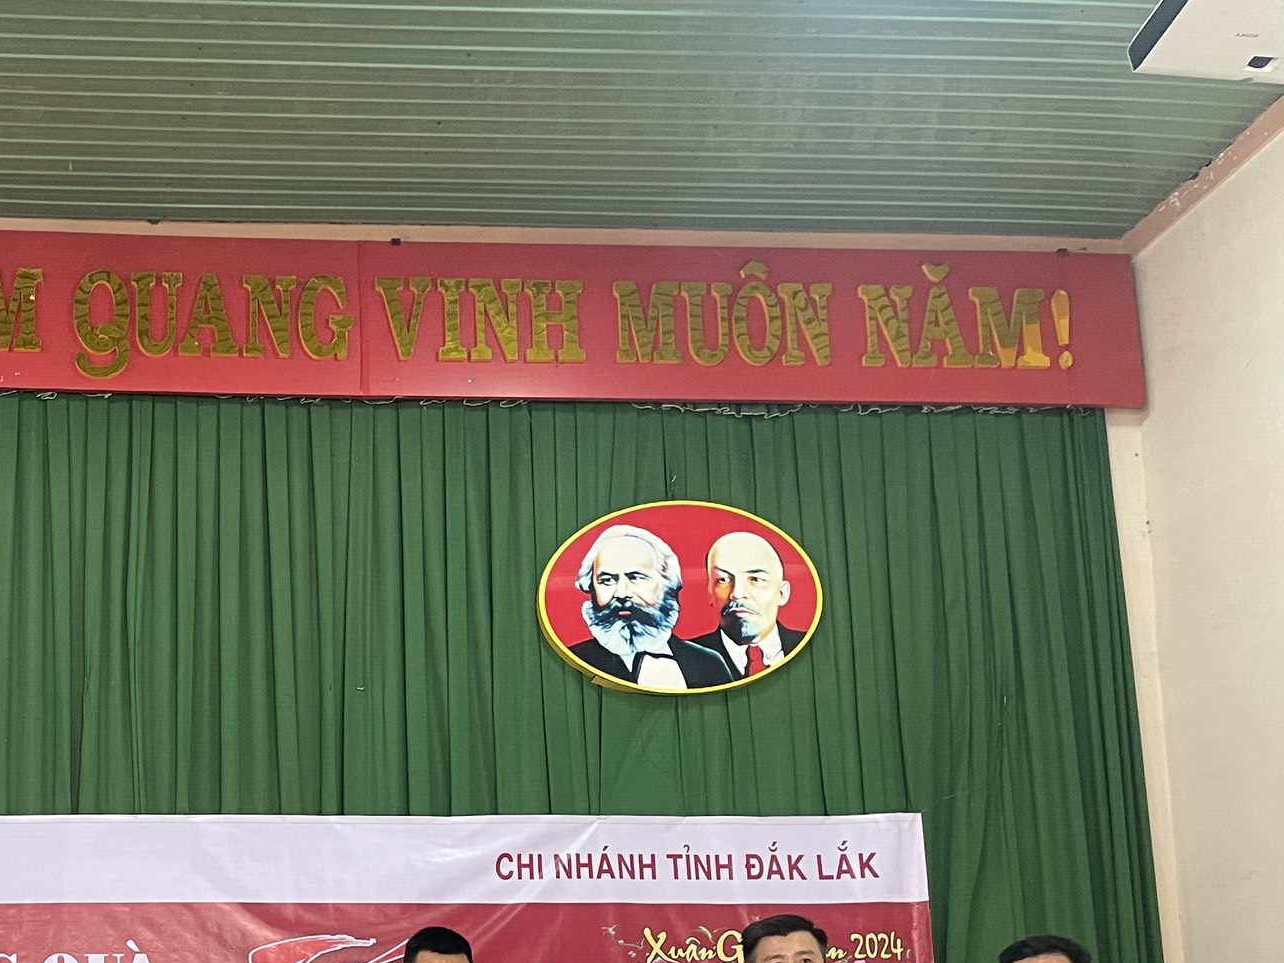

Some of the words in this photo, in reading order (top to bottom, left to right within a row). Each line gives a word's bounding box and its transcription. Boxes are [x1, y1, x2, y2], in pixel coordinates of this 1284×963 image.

[74, 268, 355, 379] QUANG
[375, 276, 587, 364] VINH
[613, 259, 833, 368] MUÔN
[858, 260, 1075, 369] NĂM!
[495, 852, 544, 881] CHI
[553, 845, 657, 880] NHÁNH
[666, 844, 734, 881] TỈNH
[744, 841, 807, 881] ĐẮK
[817, 840, 880, 880] LẮK
[850, 931, 904, 961] 2024
